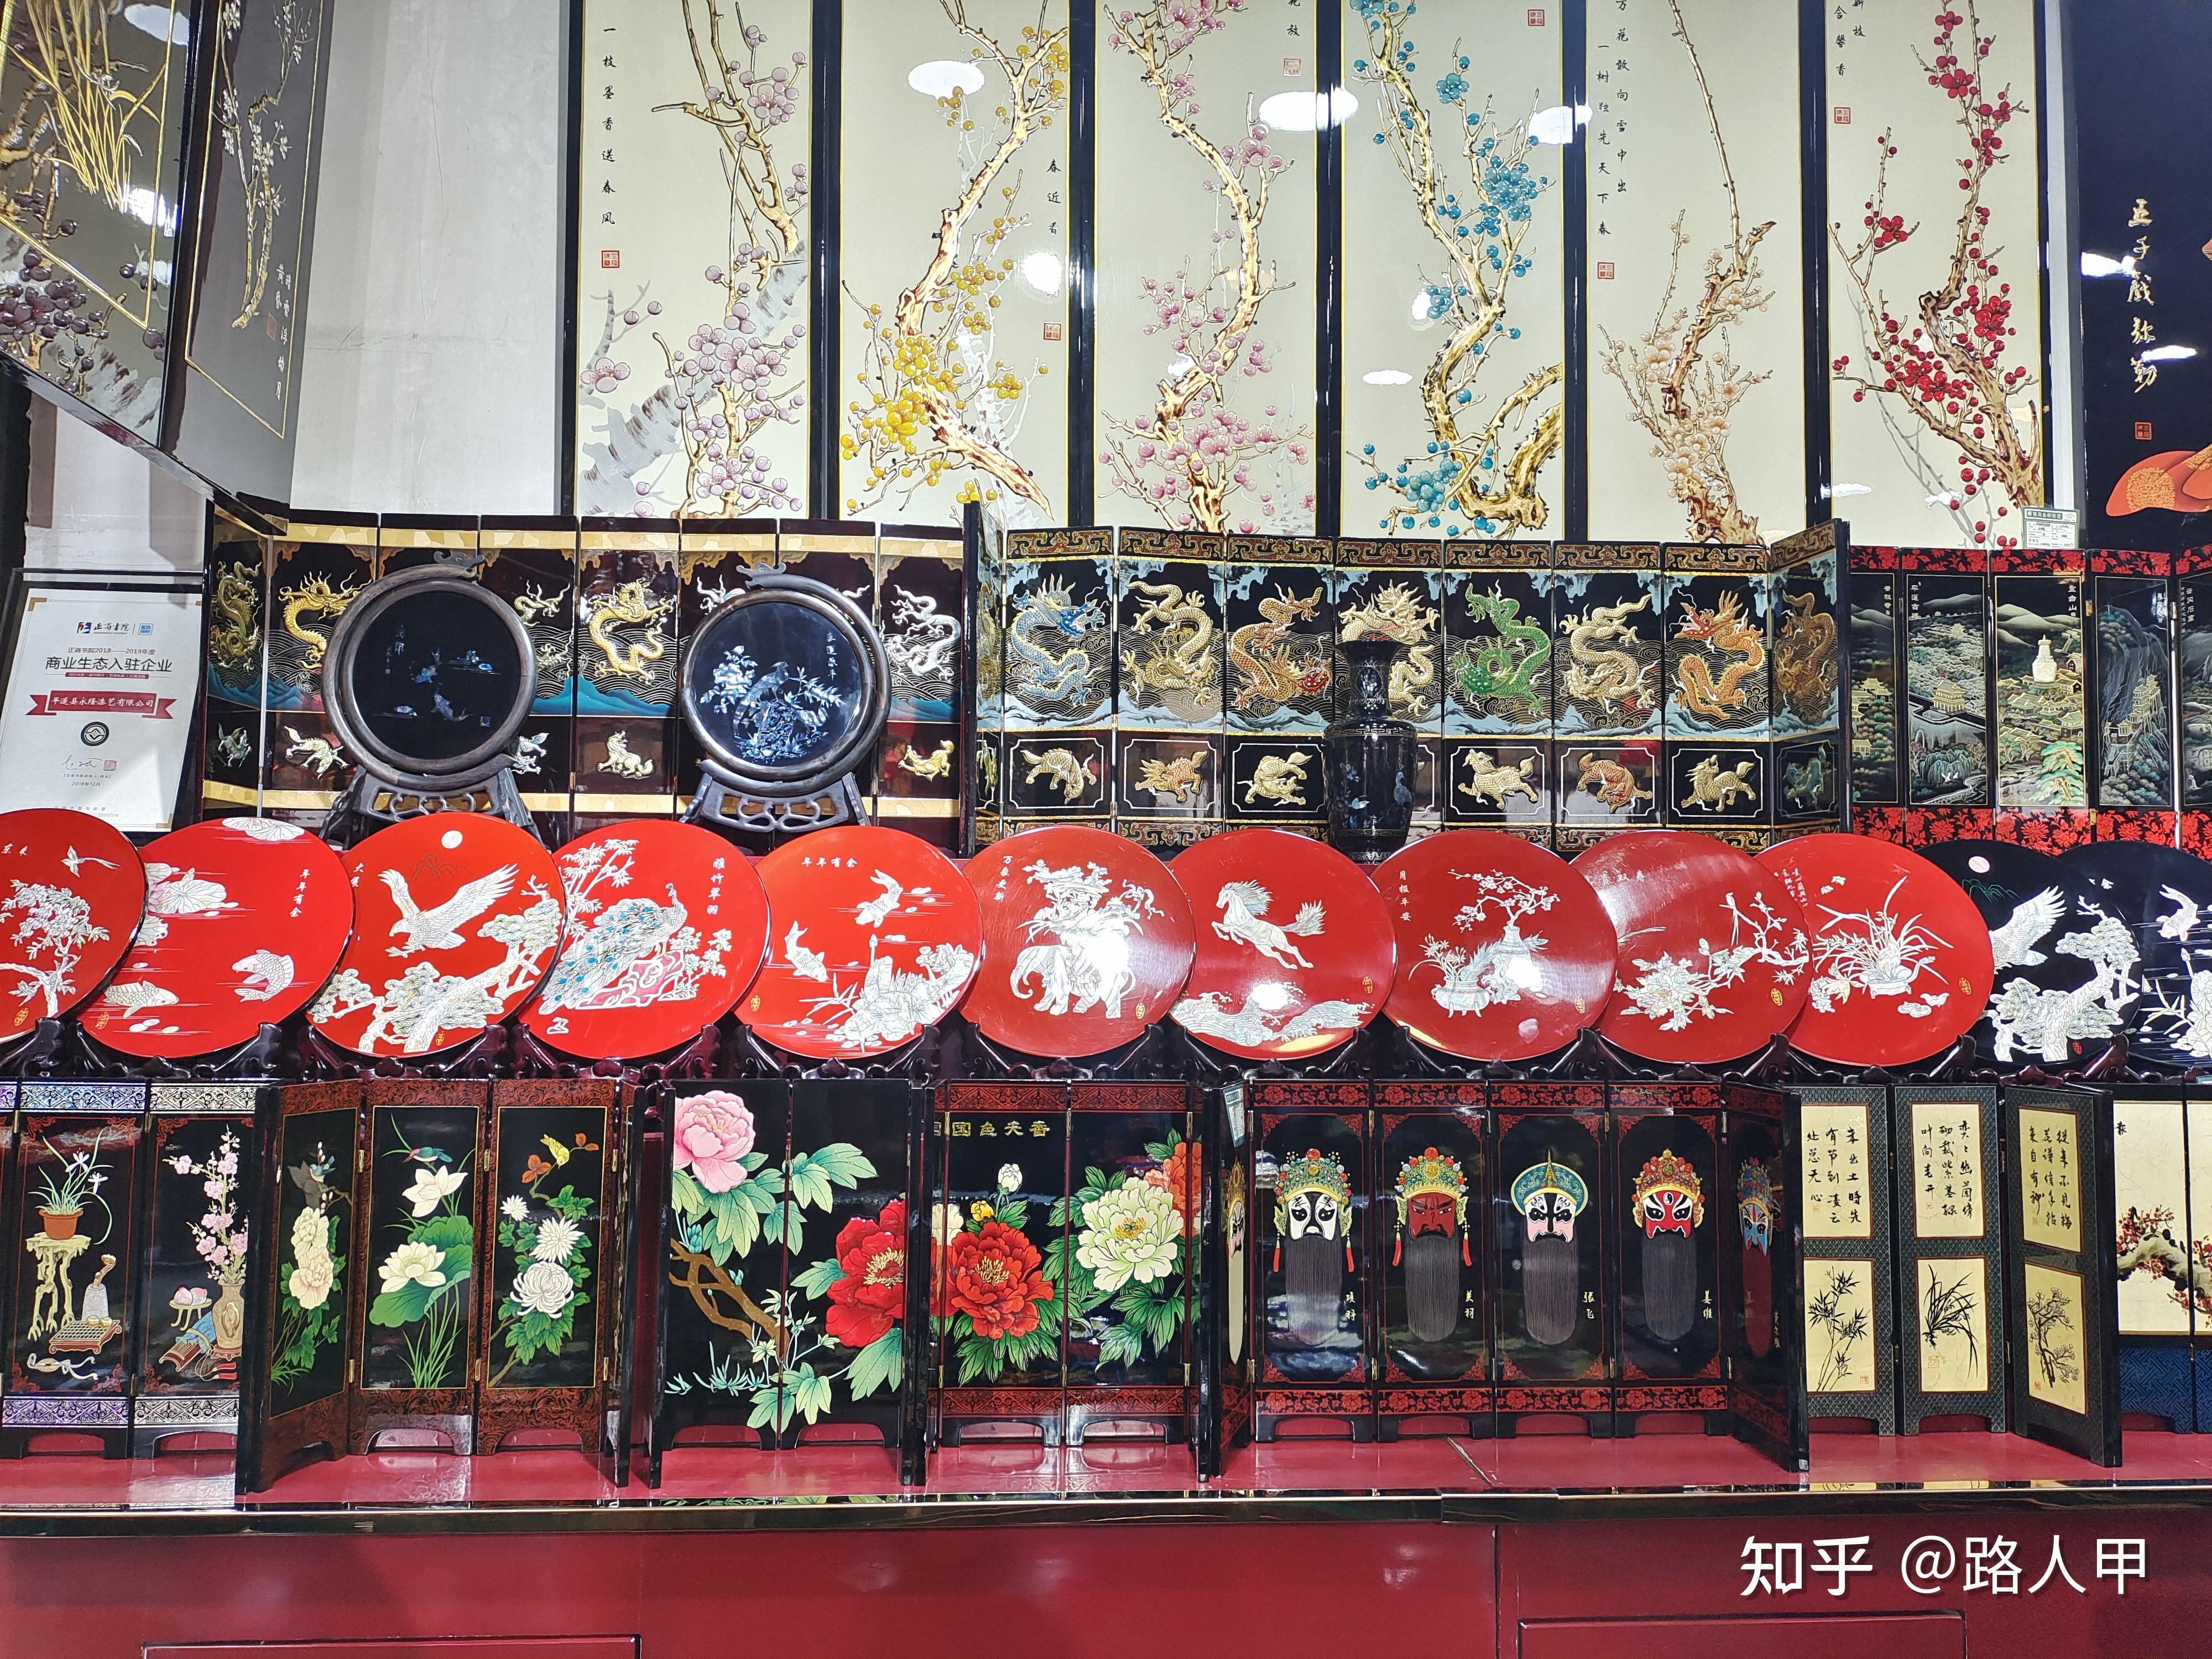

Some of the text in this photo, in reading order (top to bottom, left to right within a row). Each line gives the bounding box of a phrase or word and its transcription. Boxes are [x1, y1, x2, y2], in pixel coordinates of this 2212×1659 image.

[601, 27, 617, 225] 一枝墨香送春风
[45, 656, 173, 672] 商业生态入驻企业
[1582, 1291, 1595, 1319] 张飞
